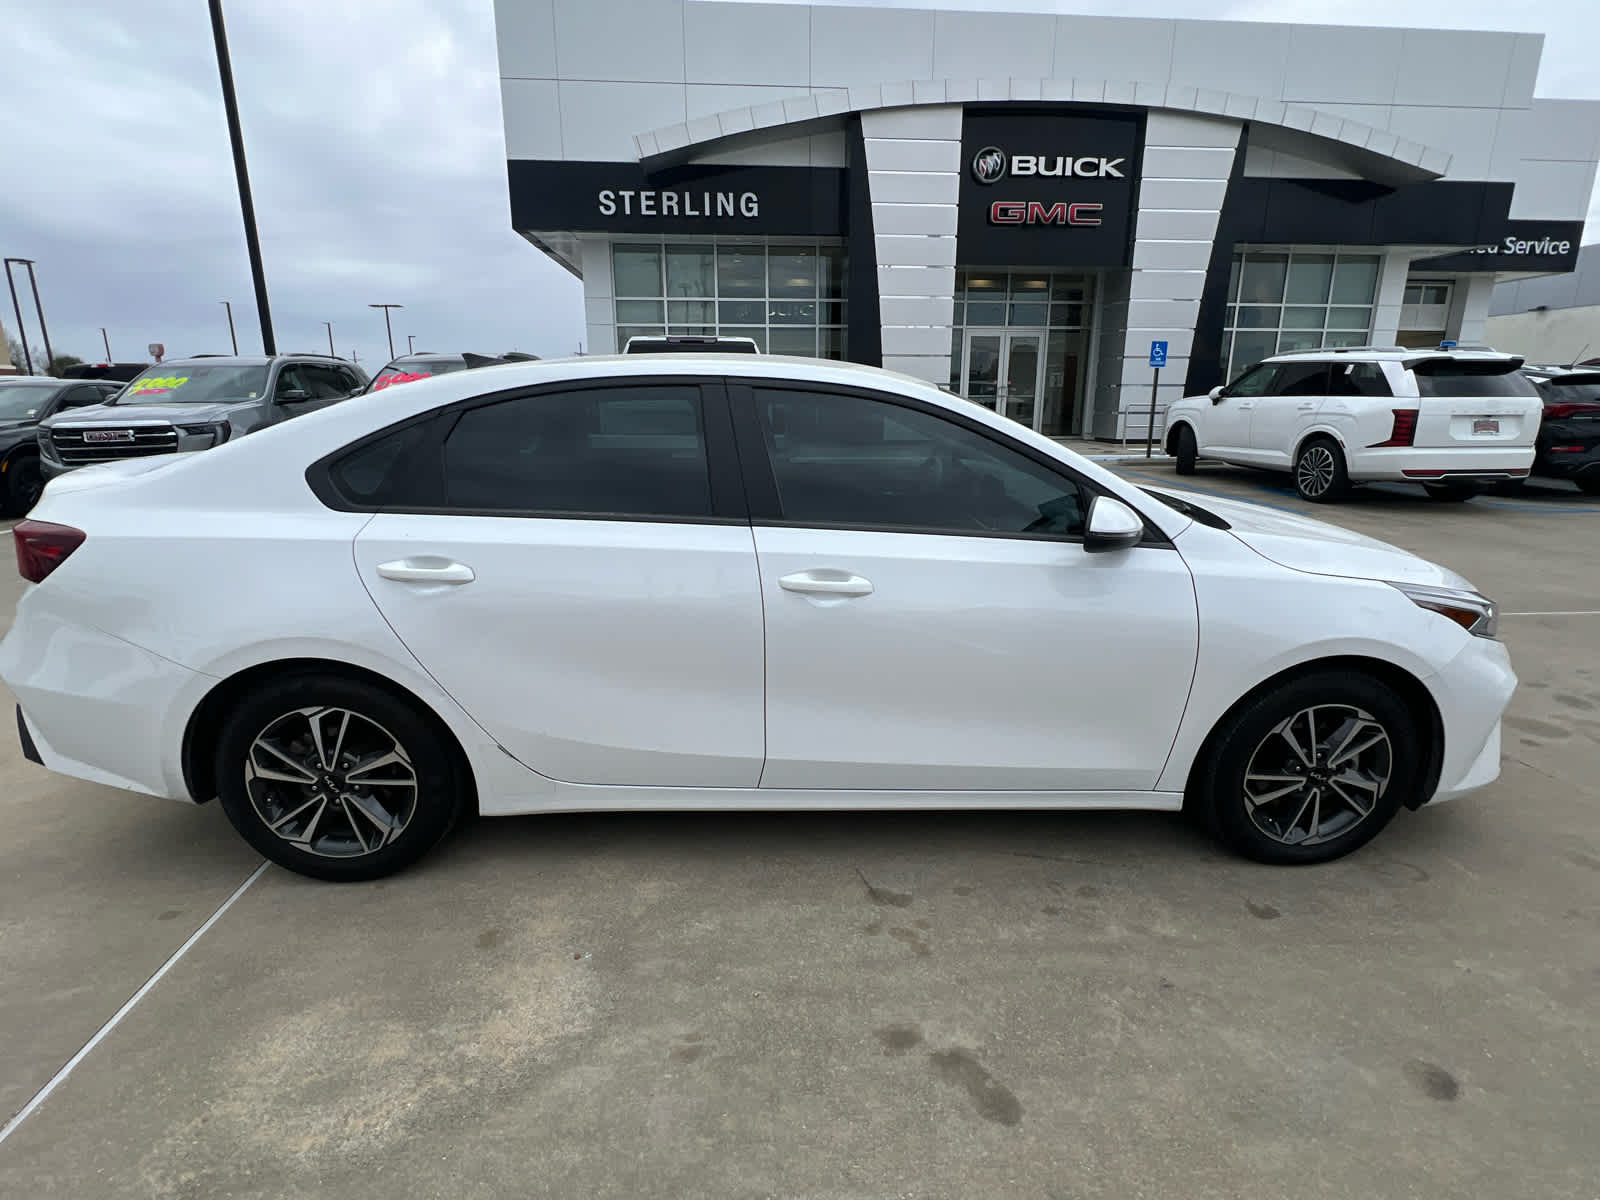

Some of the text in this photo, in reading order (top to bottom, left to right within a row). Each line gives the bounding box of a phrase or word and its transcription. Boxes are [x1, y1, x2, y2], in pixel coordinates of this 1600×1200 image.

[1011, 155, 1126, 178] BUICK
[598, 189, 759, 217] STERLING
[991, 201, 1103, 225] GMC
[1503, 236, 1570, 255] Service
